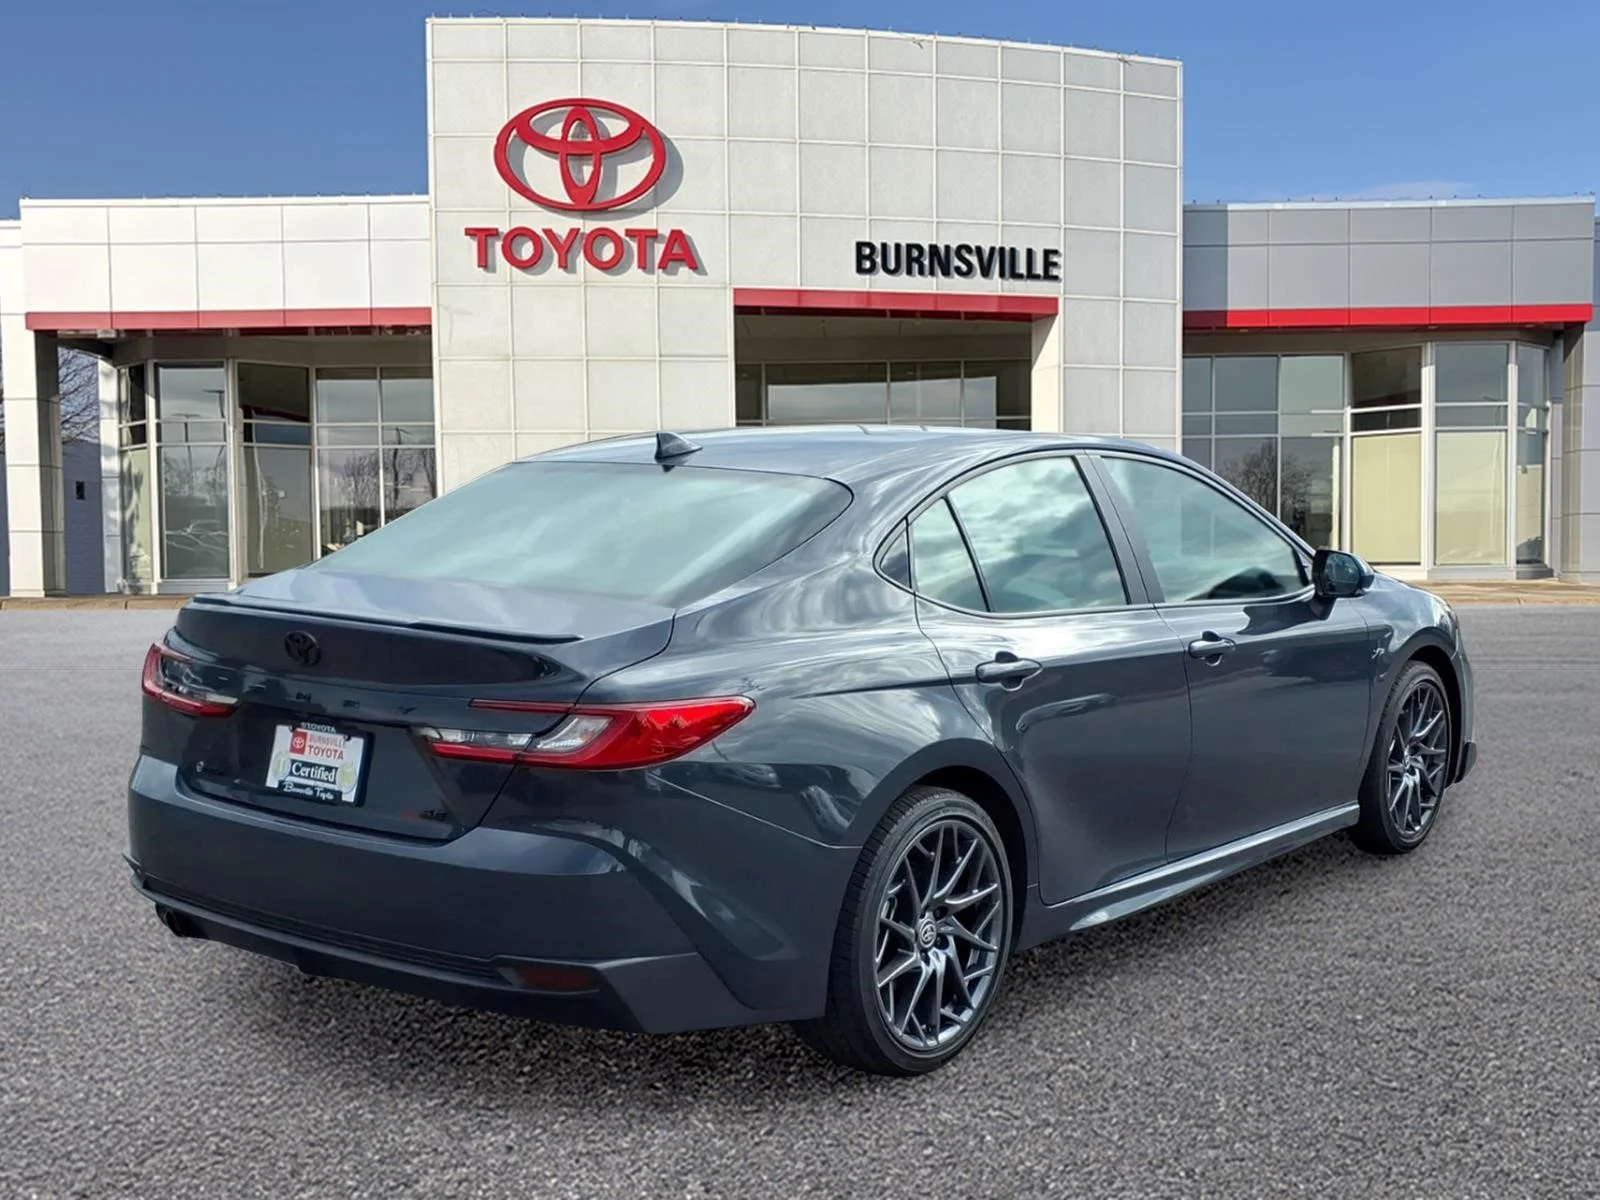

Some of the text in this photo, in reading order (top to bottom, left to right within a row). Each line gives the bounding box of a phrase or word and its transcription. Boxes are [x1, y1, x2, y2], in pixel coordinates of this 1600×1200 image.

[465, 227, 698, 270] TOYOTA
[855, 241, 1061, 281] BURNSVILLE
[307, 744, 345, 761] TOYOTA
[291, 761, 336, 783] Certified
